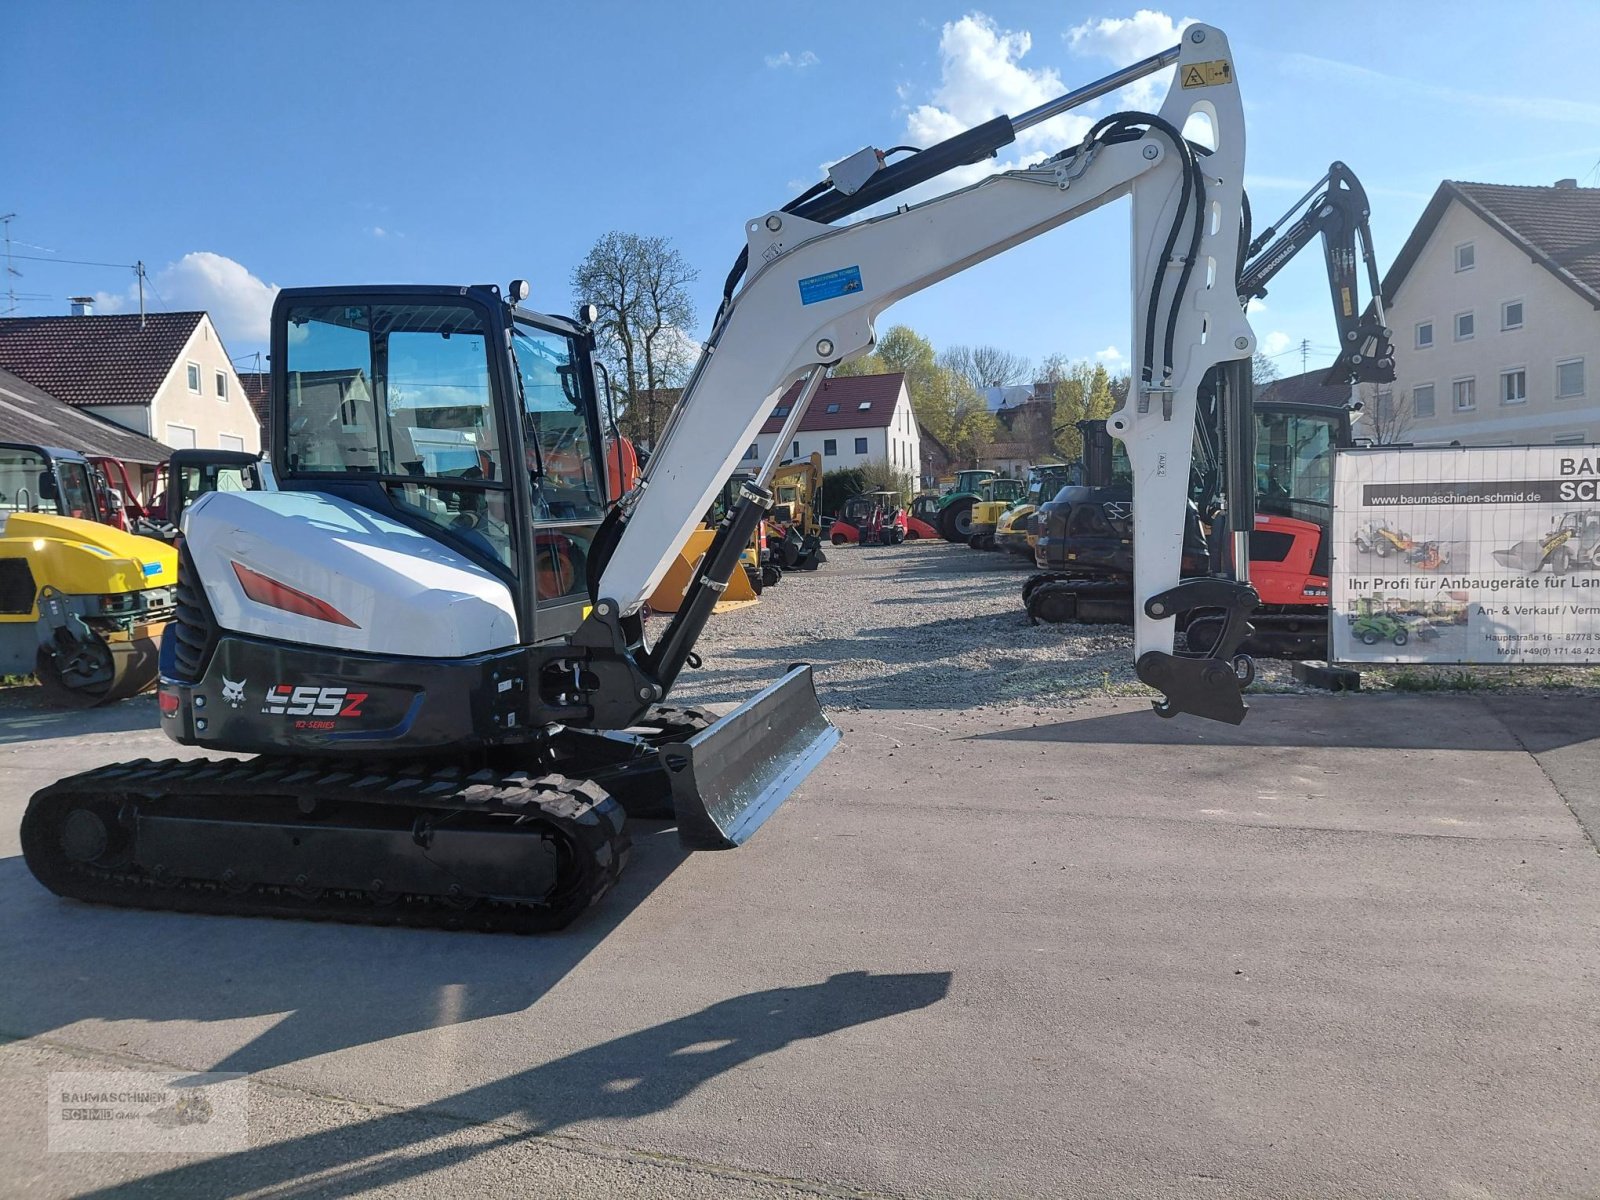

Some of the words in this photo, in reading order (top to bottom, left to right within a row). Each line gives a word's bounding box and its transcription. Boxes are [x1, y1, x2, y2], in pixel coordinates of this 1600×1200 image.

[1560, 457, 1600, 475] BA
[1560, 481, 1600, 500] SC
[1371, 492, 1541, 504] www.baumaschinen-schmid.de
[1349, 578, 1369, 590] Ihr
[1374, 577, 1409, 589] Profi
[1414, 577, 1436, 589] für
[1440, 576, 1540, 591] Anbaugeräte
[1545, 576, 1566, 588] für
[1477, 606, 1498, 615] An-
[1501, 605, 1510, 615] &
[1514, 605, 1560, 615] Verkauf
[1562, 605, 1567, 615] /
[1485, 634, 1539, 642] Hauptstraße
[1565, 633, 1592, 641] 87778
[1523, 648, 1551, 656] +49(0)
